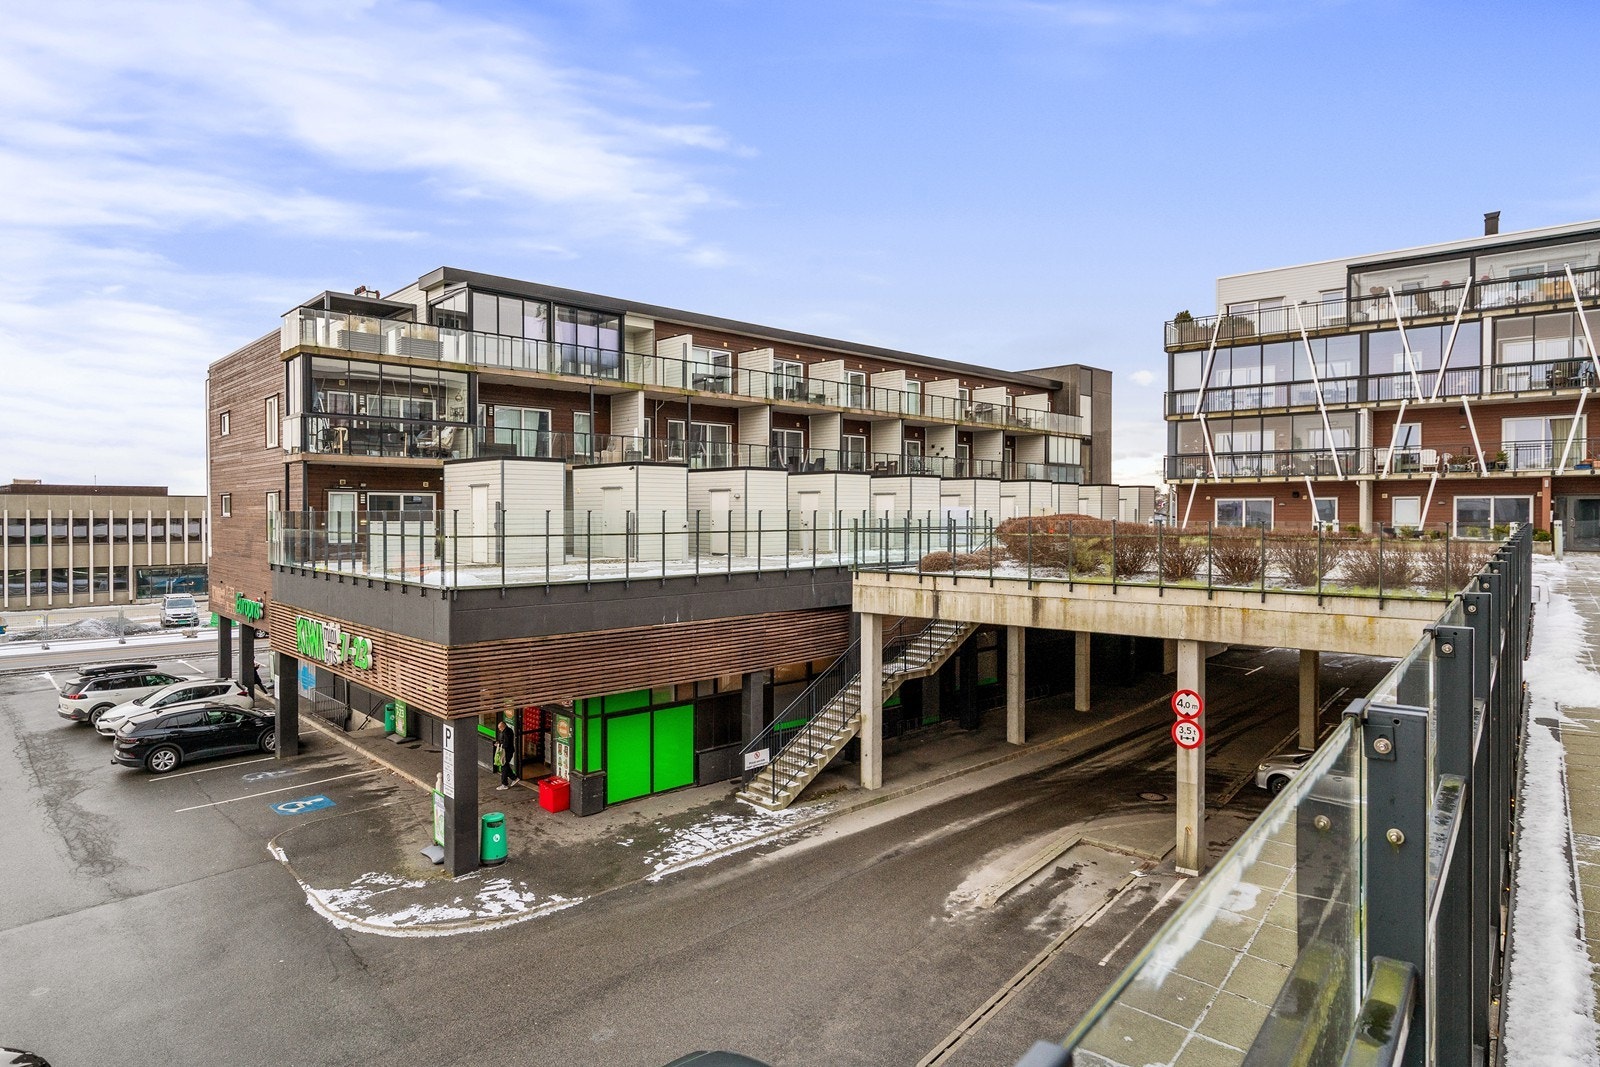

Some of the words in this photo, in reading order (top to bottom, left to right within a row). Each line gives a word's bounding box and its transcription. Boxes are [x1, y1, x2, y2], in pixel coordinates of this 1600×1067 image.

[295, 616, 325, 660] KIWI
[340, 633, 371, 670] 7-23
[445, 727, 452, 748] P
